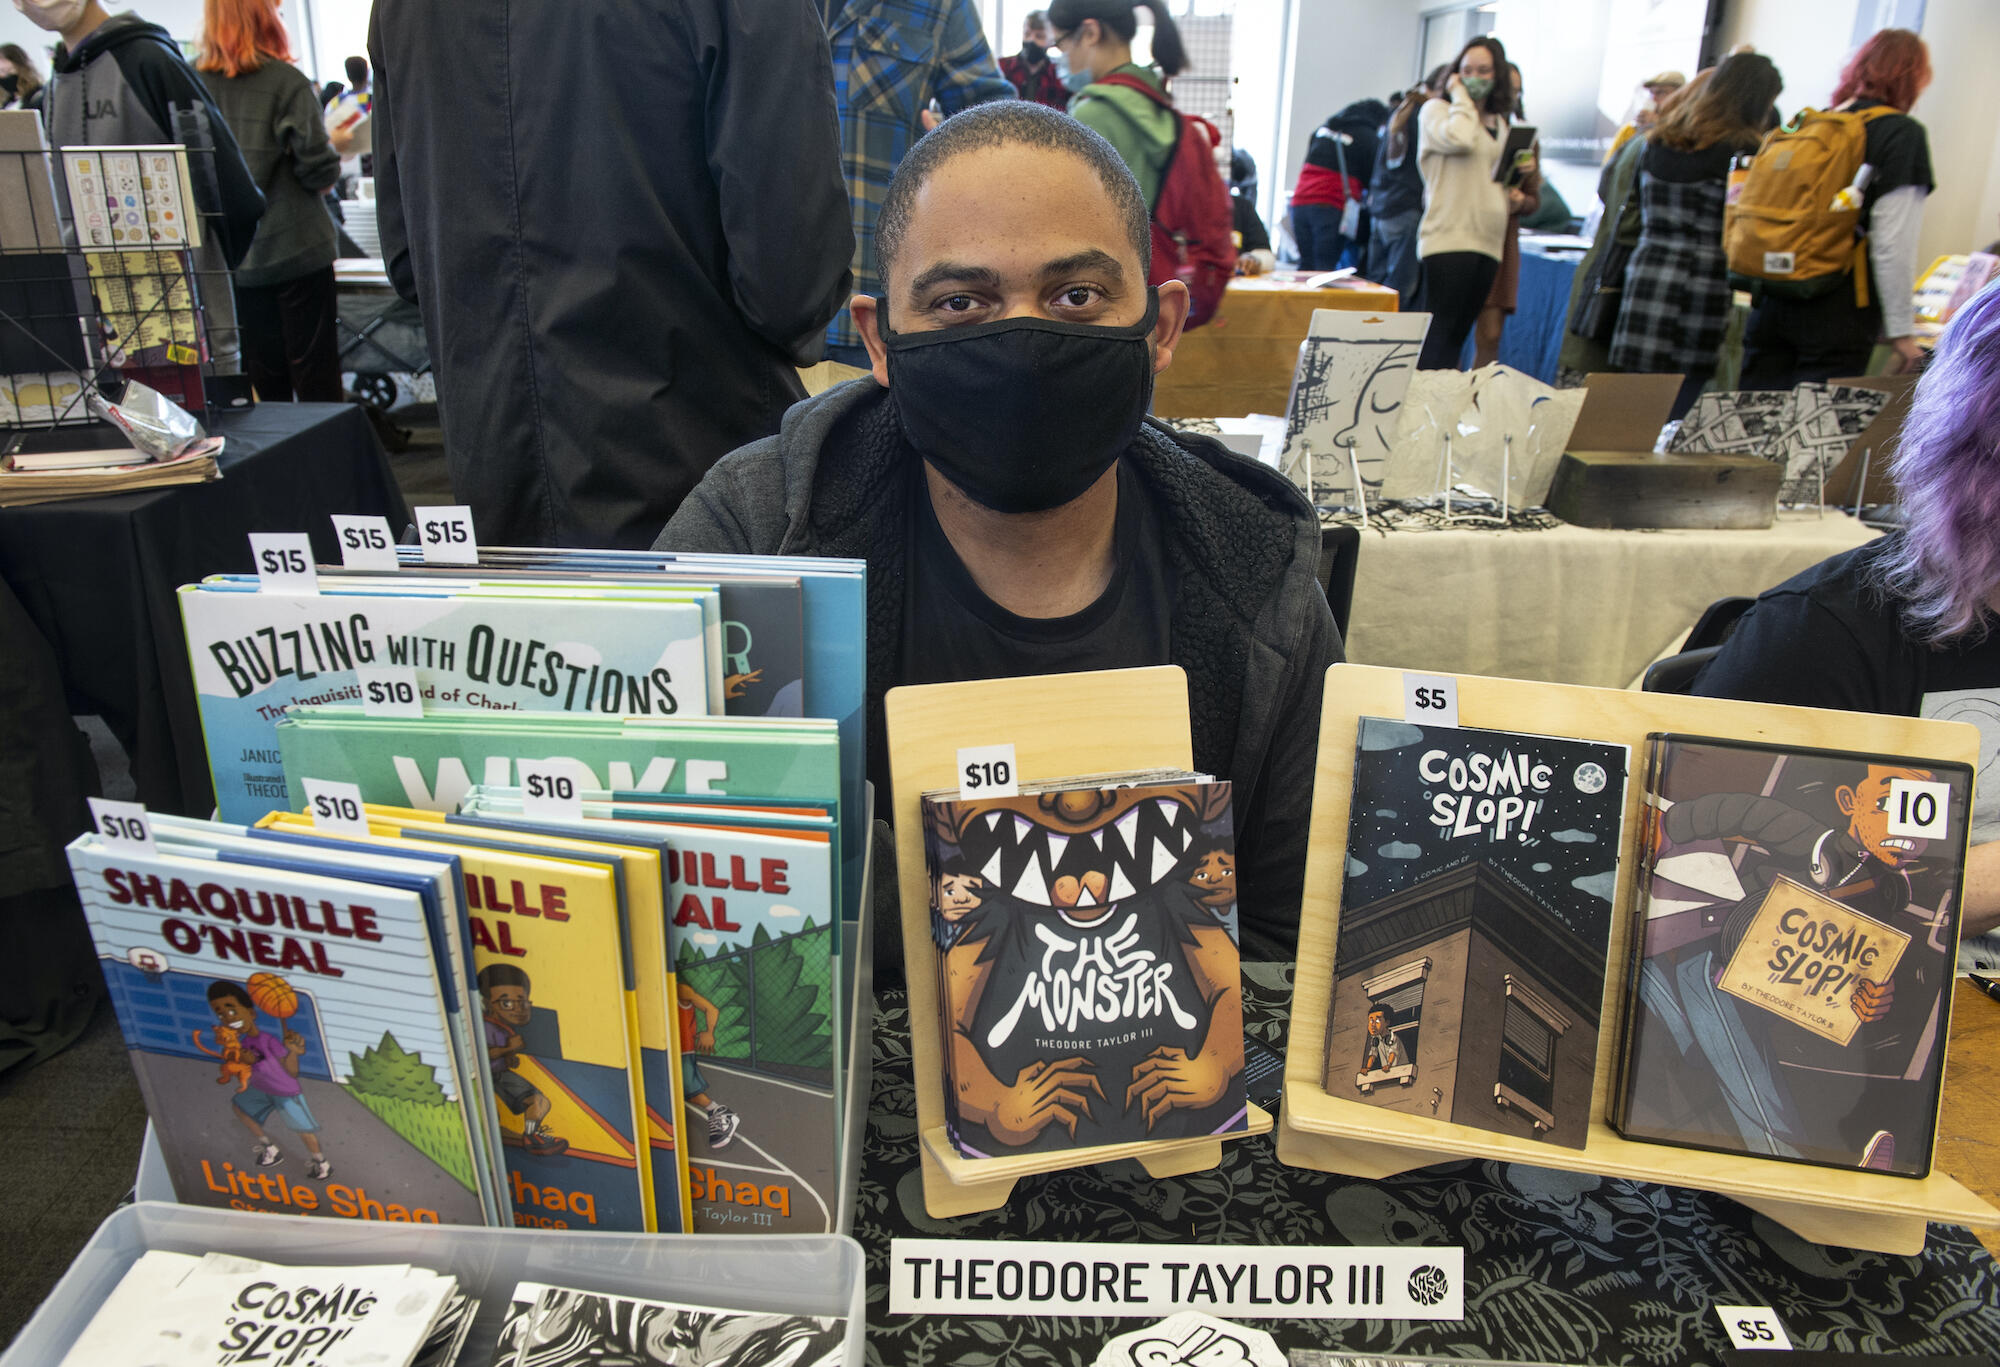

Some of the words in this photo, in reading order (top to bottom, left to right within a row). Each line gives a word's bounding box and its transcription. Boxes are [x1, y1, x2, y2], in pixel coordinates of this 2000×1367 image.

[343, 527, 387, 550] $15
[425, 520, 468, 545] $15
[261, 549, 306, 575] $15
[209, 613, 376, 699] BUZZING
[386, 634, 456, 672] WITH
[466, 624, 679, 716] QUESTIONS
[367, 681, 413, 704] $10
[441, 689, 461, 702] of
[466, 692, 524, 711] Charl
[1414, 687, 1447, 710] $5
[527, 773, 573, 800] $10
[965, 760, 1010, 788] $10
[1418, 748, 1553, 797] COSMIC
[101, 814, 146, 841] $10
[314, 794, 359, 821] $10
[1428, 793, 1538, 843] SLOP!
[1898, 791, 1937, 827] 10
[103, 867, 383, 942] SHAQUILLE
[1500, 866, 1535, 897] THEODORE
[1536, 895, 1565, 921] TAYLOR
[161, 917, 344, 978] O'NEAL
[1035, 913, 1156, 982] THE
[1780, 907, 1880, 967] COSMIC
[1768, 945, 1852, 1002] SLOP!
[987, 962, 1198, 1049] MONSTER
[1741, 982, 1753, 992] BY
[1756, 988, 1795, 1011] THEODORE
[1796, 1006, 1827, 1026] TAYLOR
[1034, 1038, 1093, 1050] THEODORE
[1097, 1031, 1139, 1048] TAYLOR
[1141, 1028, 1154, 1040] III
[200, 1159, 319, 1210] Little
[506, 1170, 597, 1225] haq
[513, 1211, 569, 1230] ance
[702, 1207, 749, 1225] Taylor
[752, 1212, 773, 1227] III
[904, 1258, 1149, 1304] THEODORE
[1162, 1263, 1334, 1305] TAYLOR
[1348, 1265, 1384, 1306] III
[237, 1281, 378, 1325] COSMIC
[1737, 1319, 1775, 1341] $5
